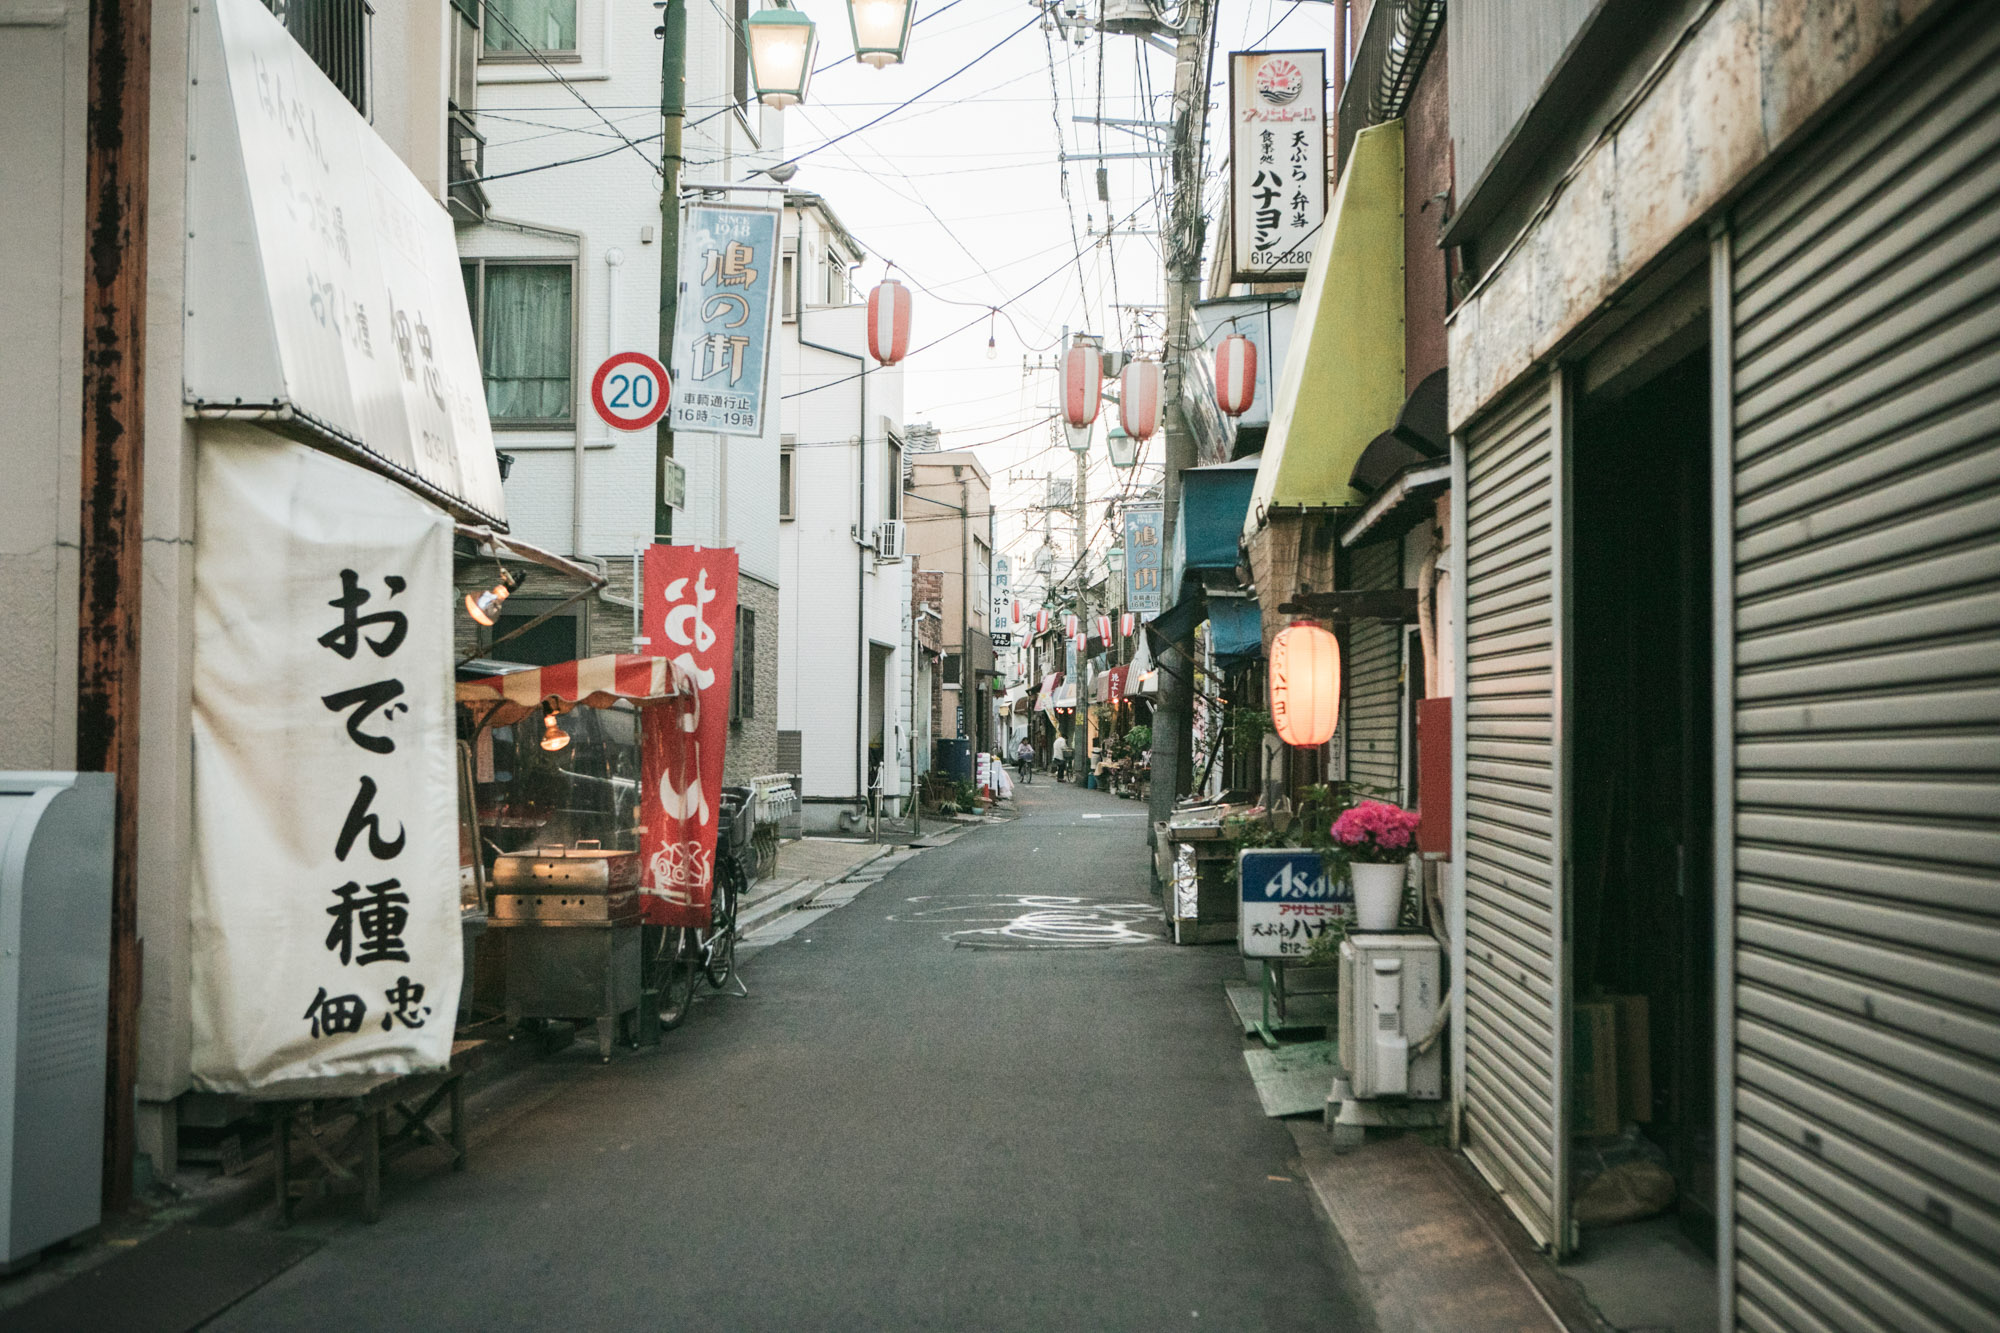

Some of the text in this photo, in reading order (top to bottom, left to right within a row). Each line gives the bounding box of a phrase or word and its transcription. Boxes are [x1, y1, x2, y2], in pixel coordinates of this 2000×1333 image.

[719, 214, 750, 225] SINCE
[1252, 170, 1283, 251] ハナヨシ
[714, 223, 750, 237] 1948
[1251, 251, 1312, 265] 612-3280
[692, 240, 758, 387] 鳩の街
[610, 374, 652, 408] 20
[317, 569, 410, 966] おでん種
[1265, 862, 1353, 898] Asah
[1279, 904, 1344, 916] アサヒビール
[303, 975, 432, 1040] 佃忠
